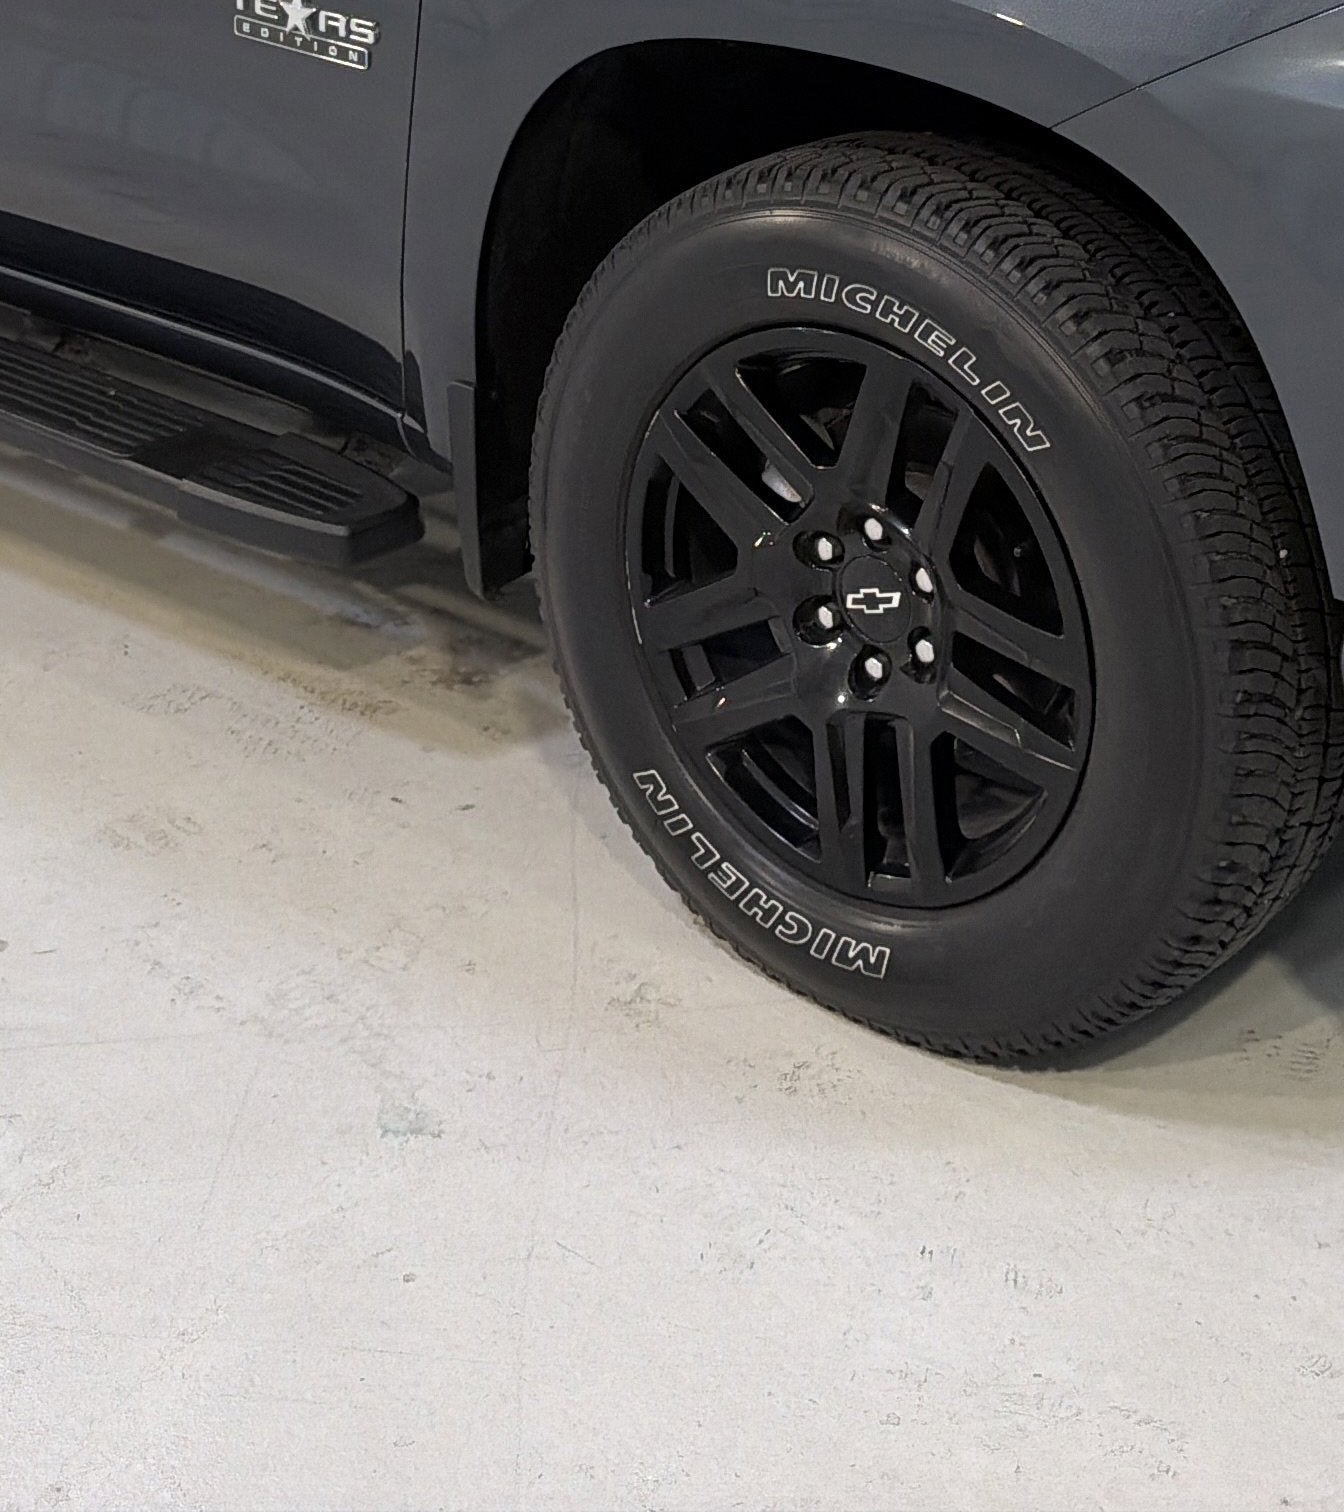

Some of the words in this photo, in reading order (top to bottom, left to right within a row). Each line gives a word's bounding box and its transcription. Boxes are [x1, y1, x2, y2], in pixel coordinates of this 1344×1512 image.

[242, 22, 359, 62] EDITION
[767, 267, 1051, 451] MICHELIN
[633, 769, 891, 979] MICHELIN
